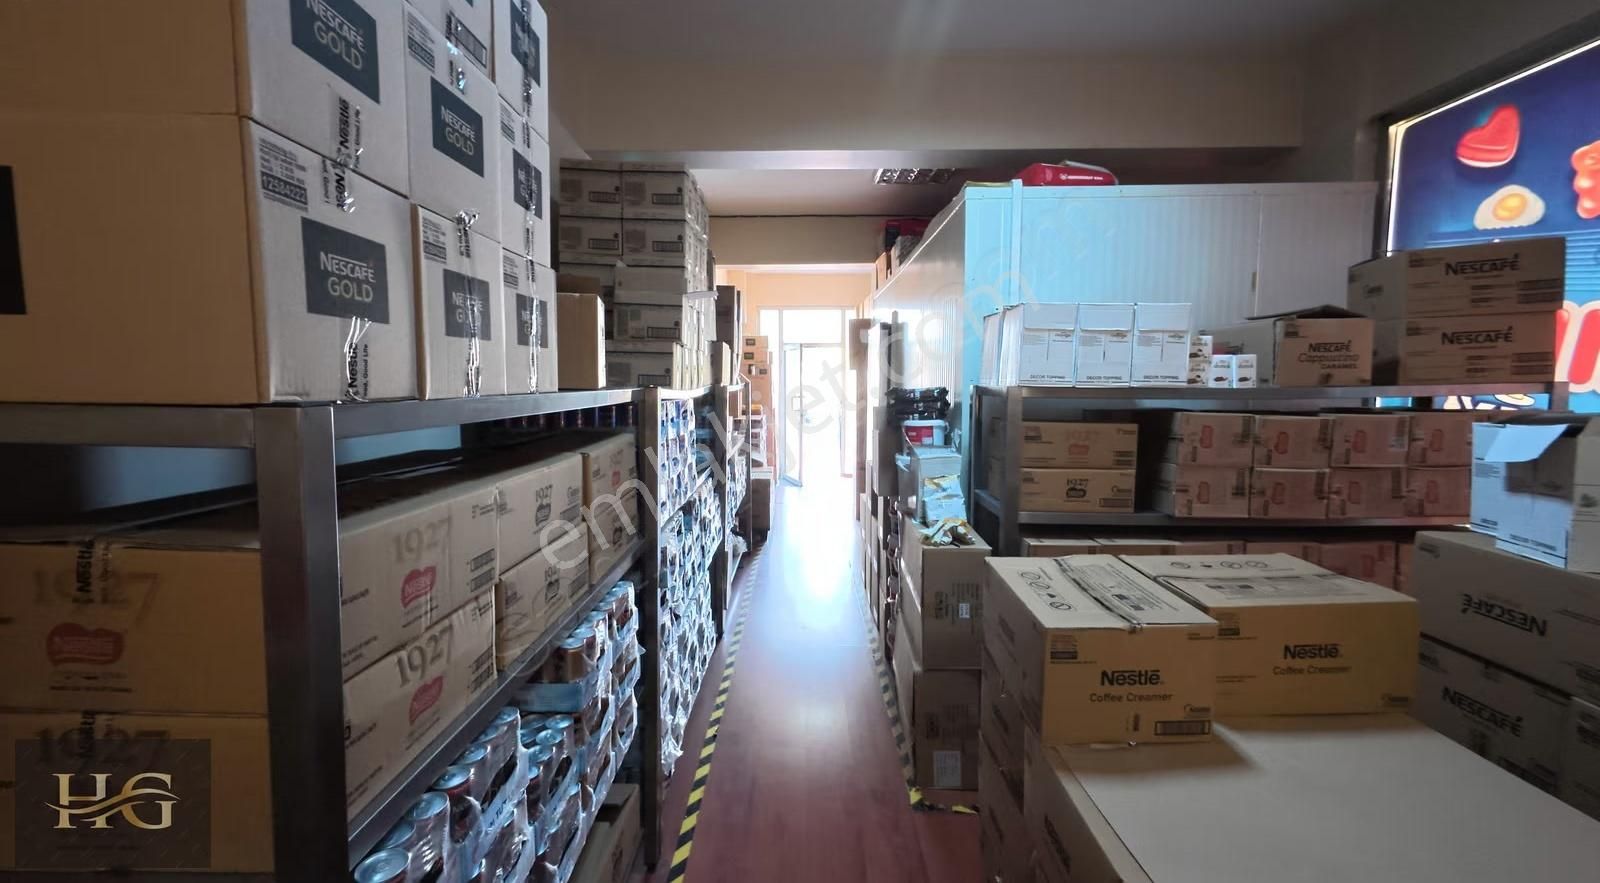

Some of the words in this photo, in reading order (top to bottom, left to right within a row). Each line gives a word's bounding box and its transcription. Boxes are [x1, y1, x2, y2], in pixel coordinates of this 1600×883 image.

[314, 21, 362, 70] GOLD
[445, 127, 474, 156] GOLD
[328, 277, 373, 302] GOLD
[535, 484, 553, 503] 1927
[1066, 478, 1089, 488] 1927
[393, 516, 452, 564] 1927
[394, 622, 453, 688] 1927
[1272, 665, 1305, 675] Coffee
[1089, 693, 1123, 702] Coffee
[1126, 692, 1173, 702] Creamer
